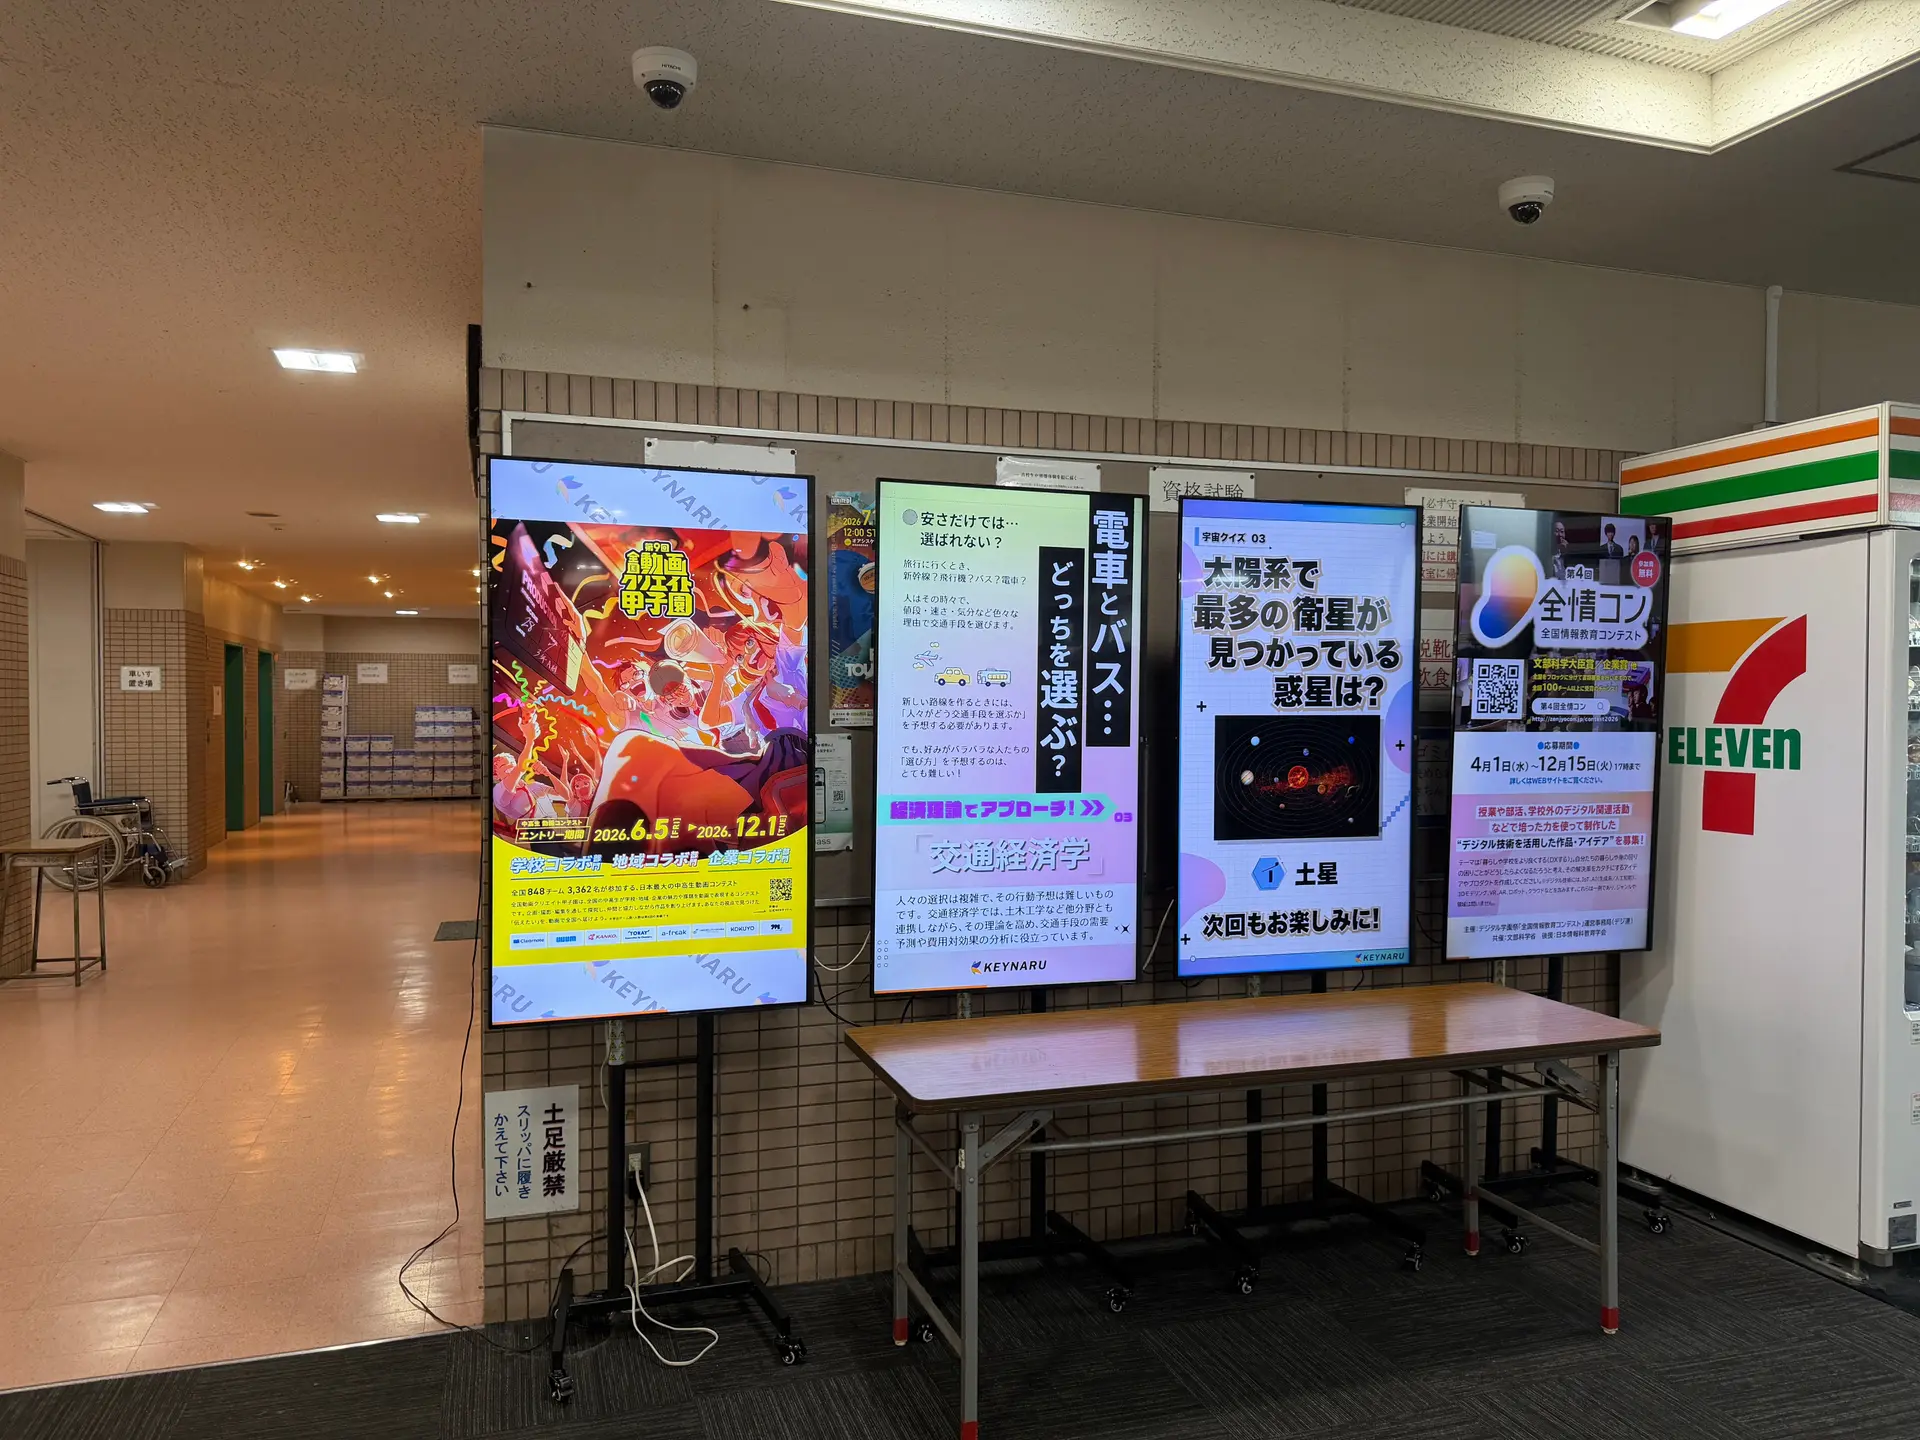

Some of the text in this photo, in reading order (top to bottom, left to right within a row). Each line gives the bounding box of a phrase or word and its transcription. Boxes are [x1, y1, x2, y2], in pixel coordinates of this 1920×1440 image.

[1163, 480, 1245, 502] 資格試験
[843, 517, 861, 526] 2026
[920, 511, 1020, 530] 安さだけでは…
[843, 528, 865, 537] 12:00
[920, 531, 1002, 549] 選ばれない？
[1202, 531, 1266, 544] 宇宙クイズ 03
[903, 559, 972, 572] 旅行に行くとき、
[1202, 555, 1320, 591] 太陽系で
[1566, 565, 1593, 580] 第4回
[621, 575, 692, 592] クリエイト
[903, 571, 1028, 585] 新幹線？飛行機？バス？電車？
[621, 591, 693, 616] 甲子園
[903, 594, 971, 605] 人はその時々で、
[1538, 586, 1647, 624] 全情コン
[903, 605, 1019, 619] 値段・速さ・気分など色々な
[1192, 594, 1389, 633] 最多の衛星が
[903, 617, 1015, 631] 理由で交通手段を選びます。
[1091, 509, 1130, 735] 電車とバス…
[1540, 627, 1642, 642] 全国情報教育コンテスト
[1207, 636, 1402, 670] 見つかっている
[128, 669, 153, 678] 車いす
[1039, 561, 1079, 777] どっちを選ぶ？
[128, 679, 153, 688] 置き場
[1273, 675, 1385, 708] 惑星は？
[902, 697, 1013, 708] 新しい路線を作るときには、
[1540, 702, 1587, 711] 第4回全情コン
[900, 708, 1027, 720] 「人々がどう交通手段を選ぶか」
[902, 720, 1013, 732] を予想する必要があります。
[901, 744, 1030, 755] でも、好みがバラバラな人たちの
[901, 768, 962, 779] とても難しい！
[1509, 776, 1604, 786] 詳しくはWEBサイトをご覧ください。
[1114, 812, 1133, 823] 03
[1477, 803, 1630, 818] 授業や部活、学校外のデジタル関連活動
[1491, 820, 1617, 833] などで培った力を使って制作した
[519, 829, 585, 841] エントリー期間
[915, 831, 1105, 876] 「交通経済学」
[1295, 861, 1339, 886] 土星
[895, 889, 1114, 907] 人々の選択は複雑で、その行動予想は難しいもの
[896, 902, 1114, 921] です。交通経済学では、土木工学など他分野とも
[895, 916, 1109, 935] 連携しながら、その理論を高め、交通手段の需要
[1202, 907, 1380, 937] 次回もお楽しみに！
[895, 931, 1095, 949] 予測や費用対効果の分析に役立っています。
[1363, 952, 1405, 962] KEYNARU
[983, 959, 1047, 973] KEYNARU
[493, 1112, 510, 1197] かえて下さい
[516, 1104, 533, 1200] スリッパに履き
[542, 1102, 566, 1198] 土足厳禁
